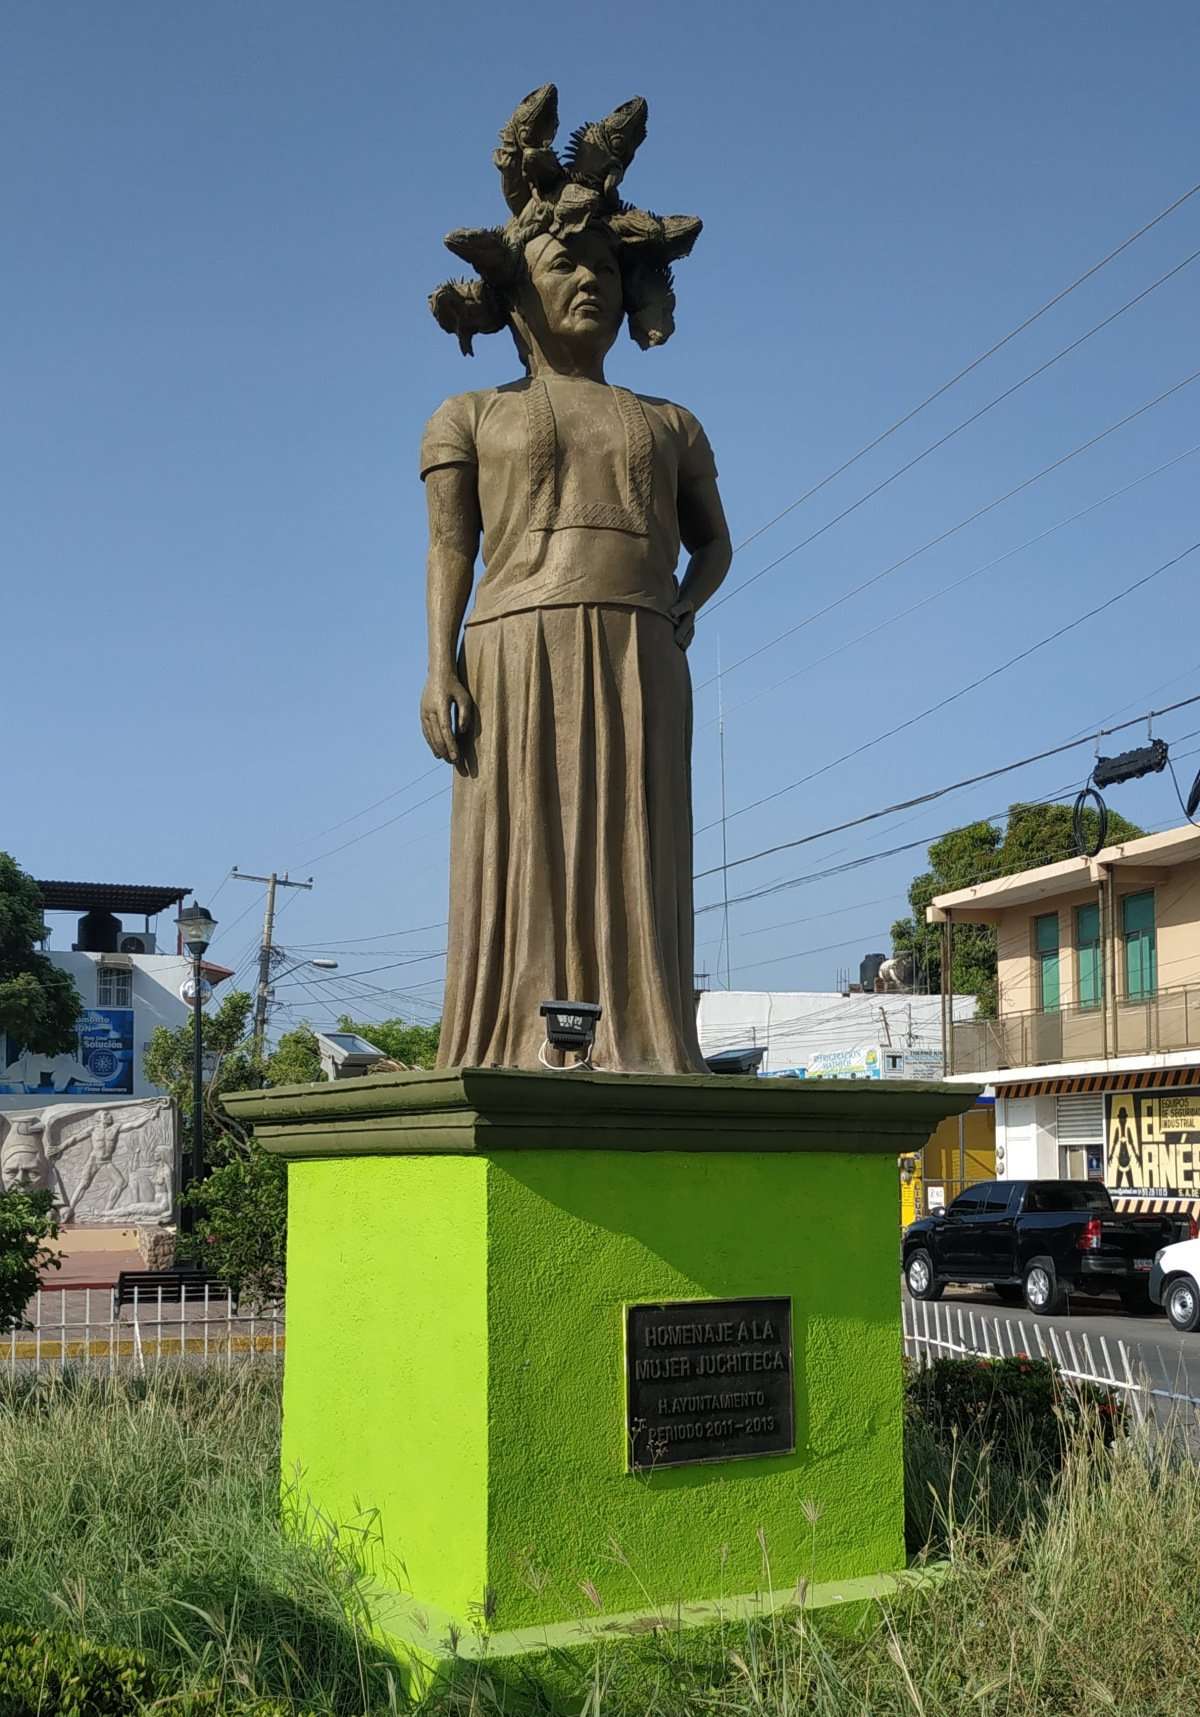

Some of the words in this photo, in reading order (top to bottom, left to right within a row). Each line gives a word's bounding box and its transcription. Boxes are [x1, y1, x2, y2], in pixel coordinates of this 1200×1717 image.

[1162, 1098, 1190, 1107] EQUIPOS
[1141, 1098, 1165, 1142] EL
[1162, 1118, 1195, 1128] INDUSTRIAL
[645, 1322, 734, 1347] HOMENAJE
[737, 1321, 749, 1341] A
[752, 1320, 774, 1341] LA
[635, 1356, 691, 1381] MUJER
[696, 1351, 785, 1375] JUCHITECA
[649, 1422, 704, 1442] PERIODO
